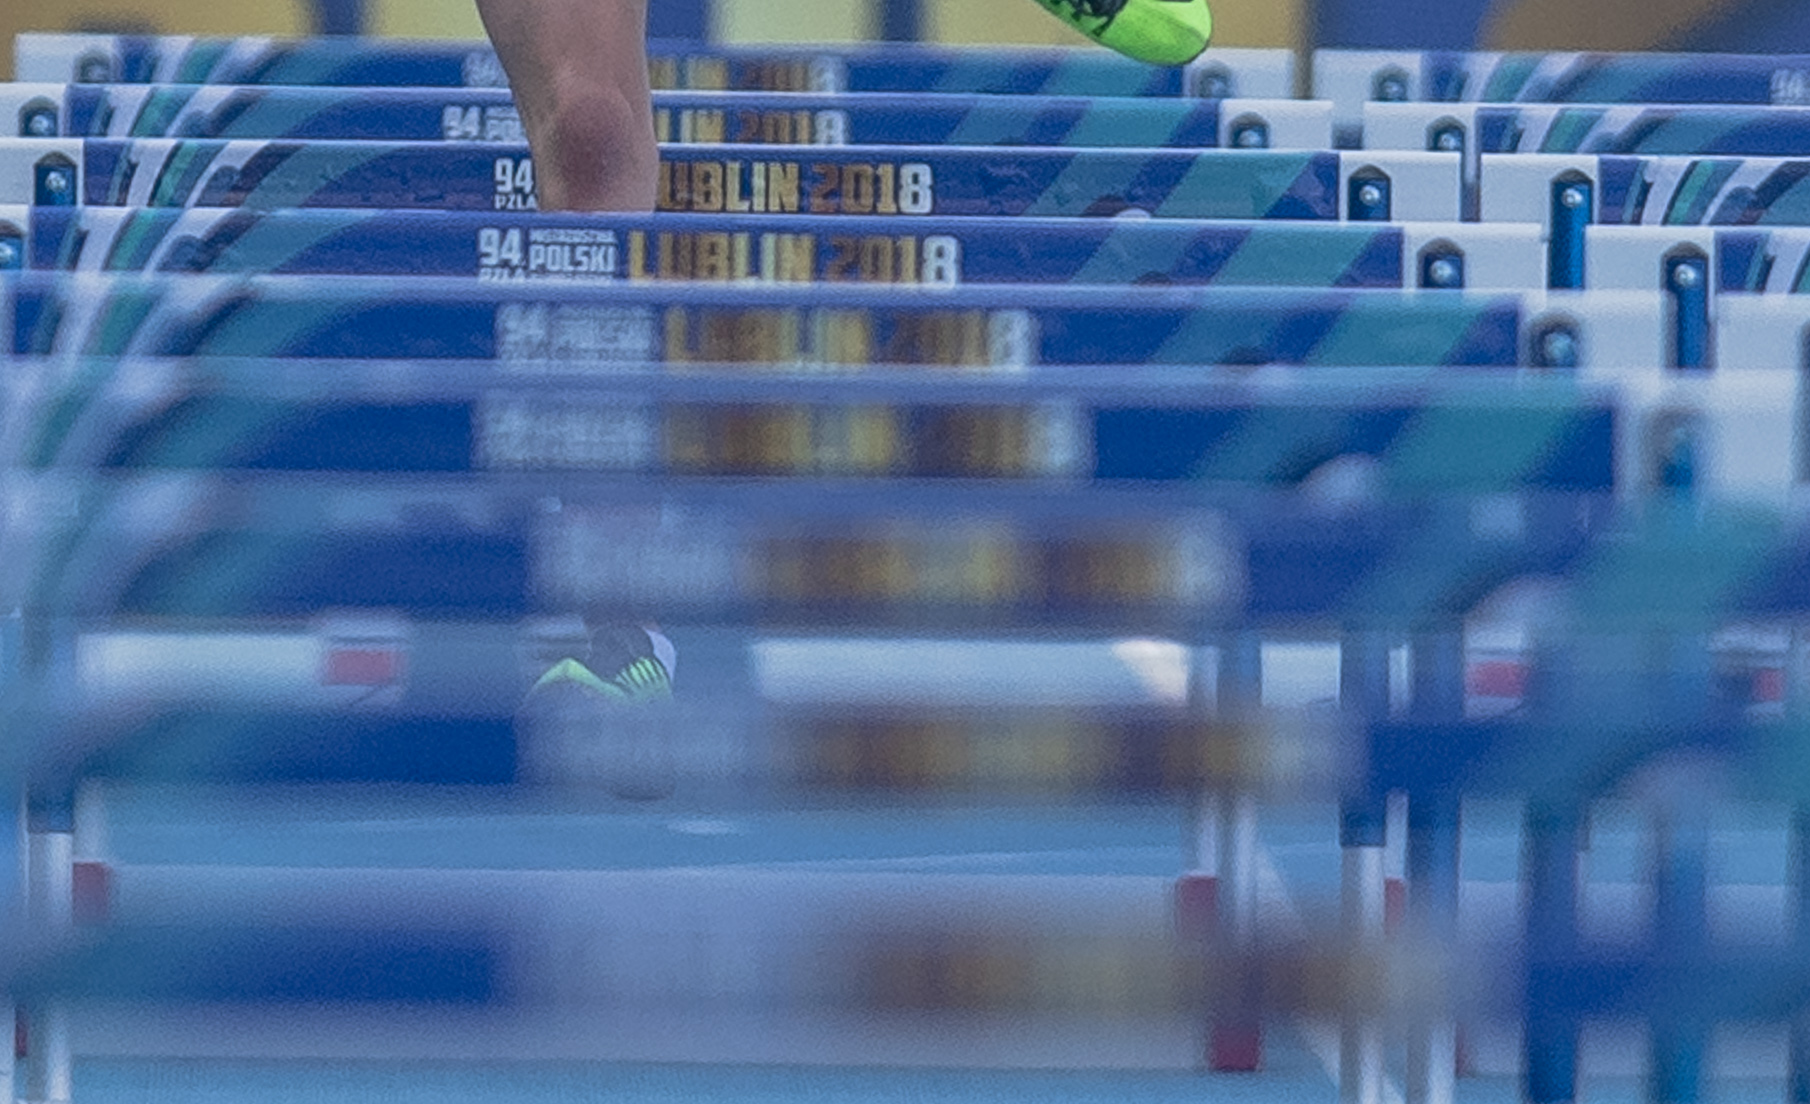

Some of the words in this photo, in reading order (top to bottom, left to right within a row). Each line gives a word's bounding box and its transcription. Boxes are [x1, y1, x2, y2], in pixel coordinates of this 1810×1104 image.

[655, 161, 799, 214] UBLIN
[810, 162, 933, 214] 2018
[529, 244, 615, 272] POLSKI
[629, 230, 815, 286] LUBLIN
[826, 235, 961, 289] 2018
